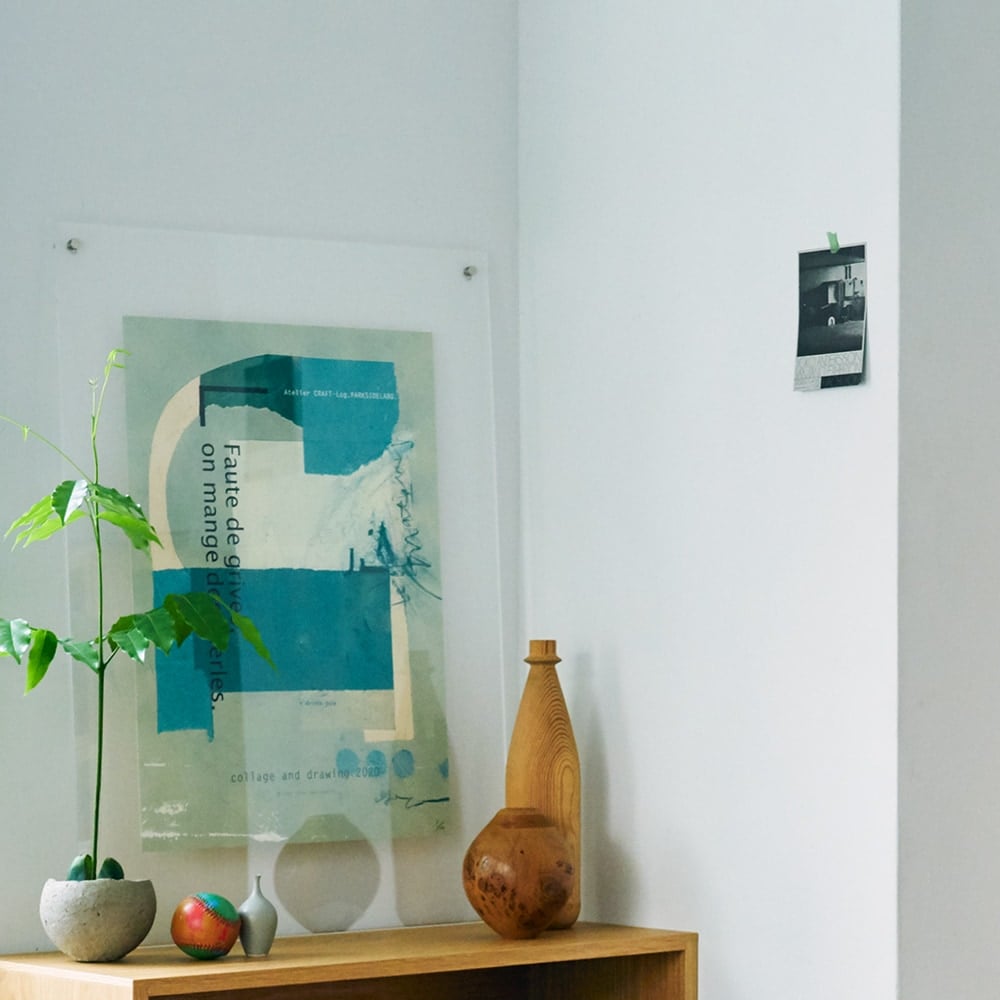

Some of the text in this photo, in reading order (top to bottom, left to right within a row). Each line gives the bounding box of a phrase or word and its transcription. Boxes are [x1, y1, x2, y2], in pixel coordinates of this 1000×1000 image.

[201, 443, 215, 472] on
[201, 483, 219, 562] mange
[223, 445, 244, 632] Faute de grive,
[210, 643, 227, 710] erles.
[231, 766, 380, 783] collage and drawing 2020
